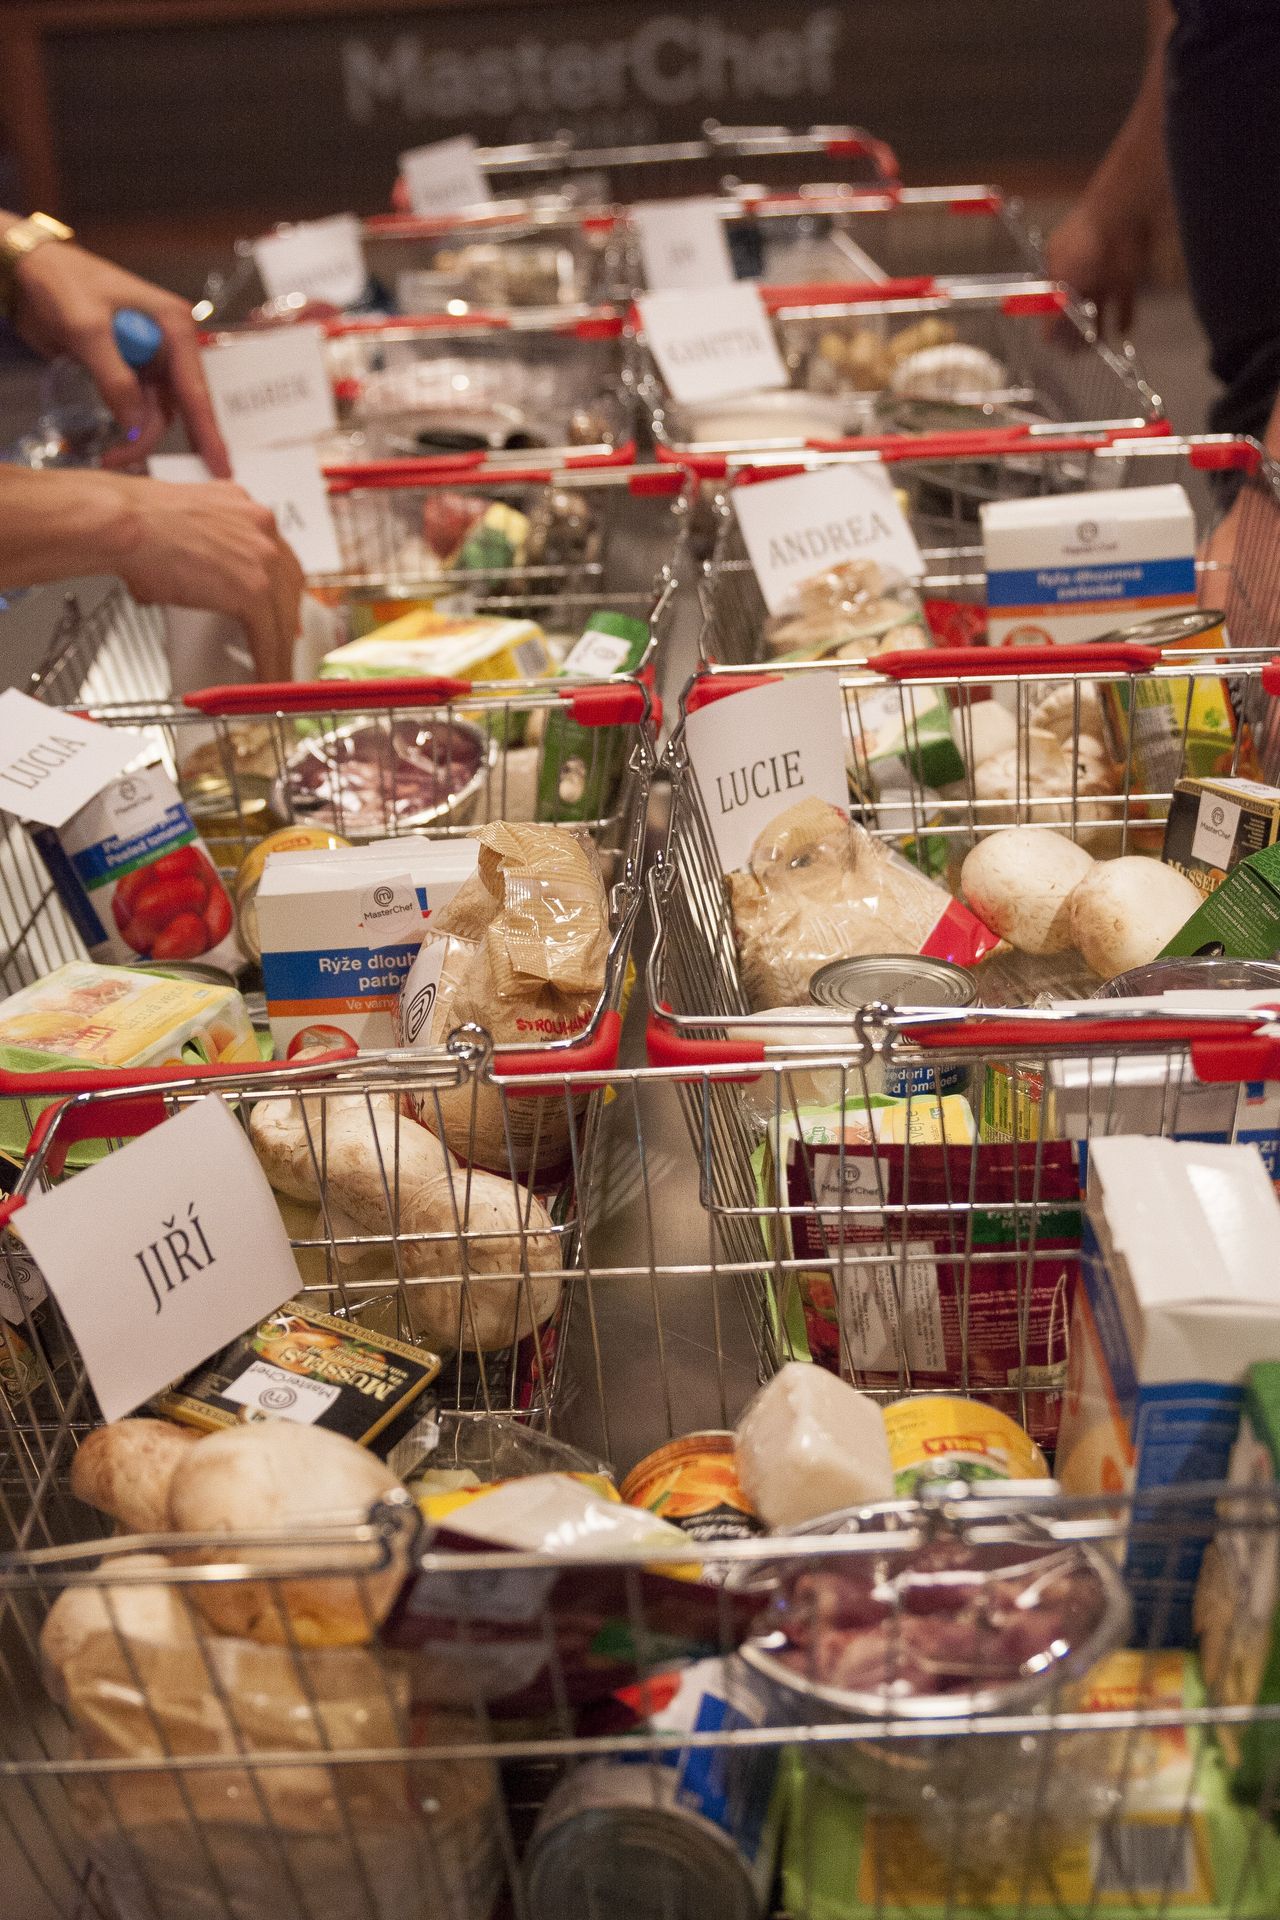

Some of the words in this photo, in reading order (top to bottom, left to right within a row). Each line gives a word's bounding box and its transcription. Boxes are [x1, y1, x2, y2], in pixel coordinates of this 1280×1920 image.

[342, 10, 838, 120] MasterChef
[769, 511, 893, 570] ANDREA
[0, 735, 86, 789] LUCIA
[716, 749, 804, 814] LUCIE
[1201, 820, 1231, 840] MasterChef
[363, 903, 414, 920] MasterChef
[319, 957, 362, 974] Rýže
[136, 1202, 216, 1315] JIŘÍ
[252, 1360, 333, 1400] MasterChef
[281, 1345, 397, 1402] MUSSELS
